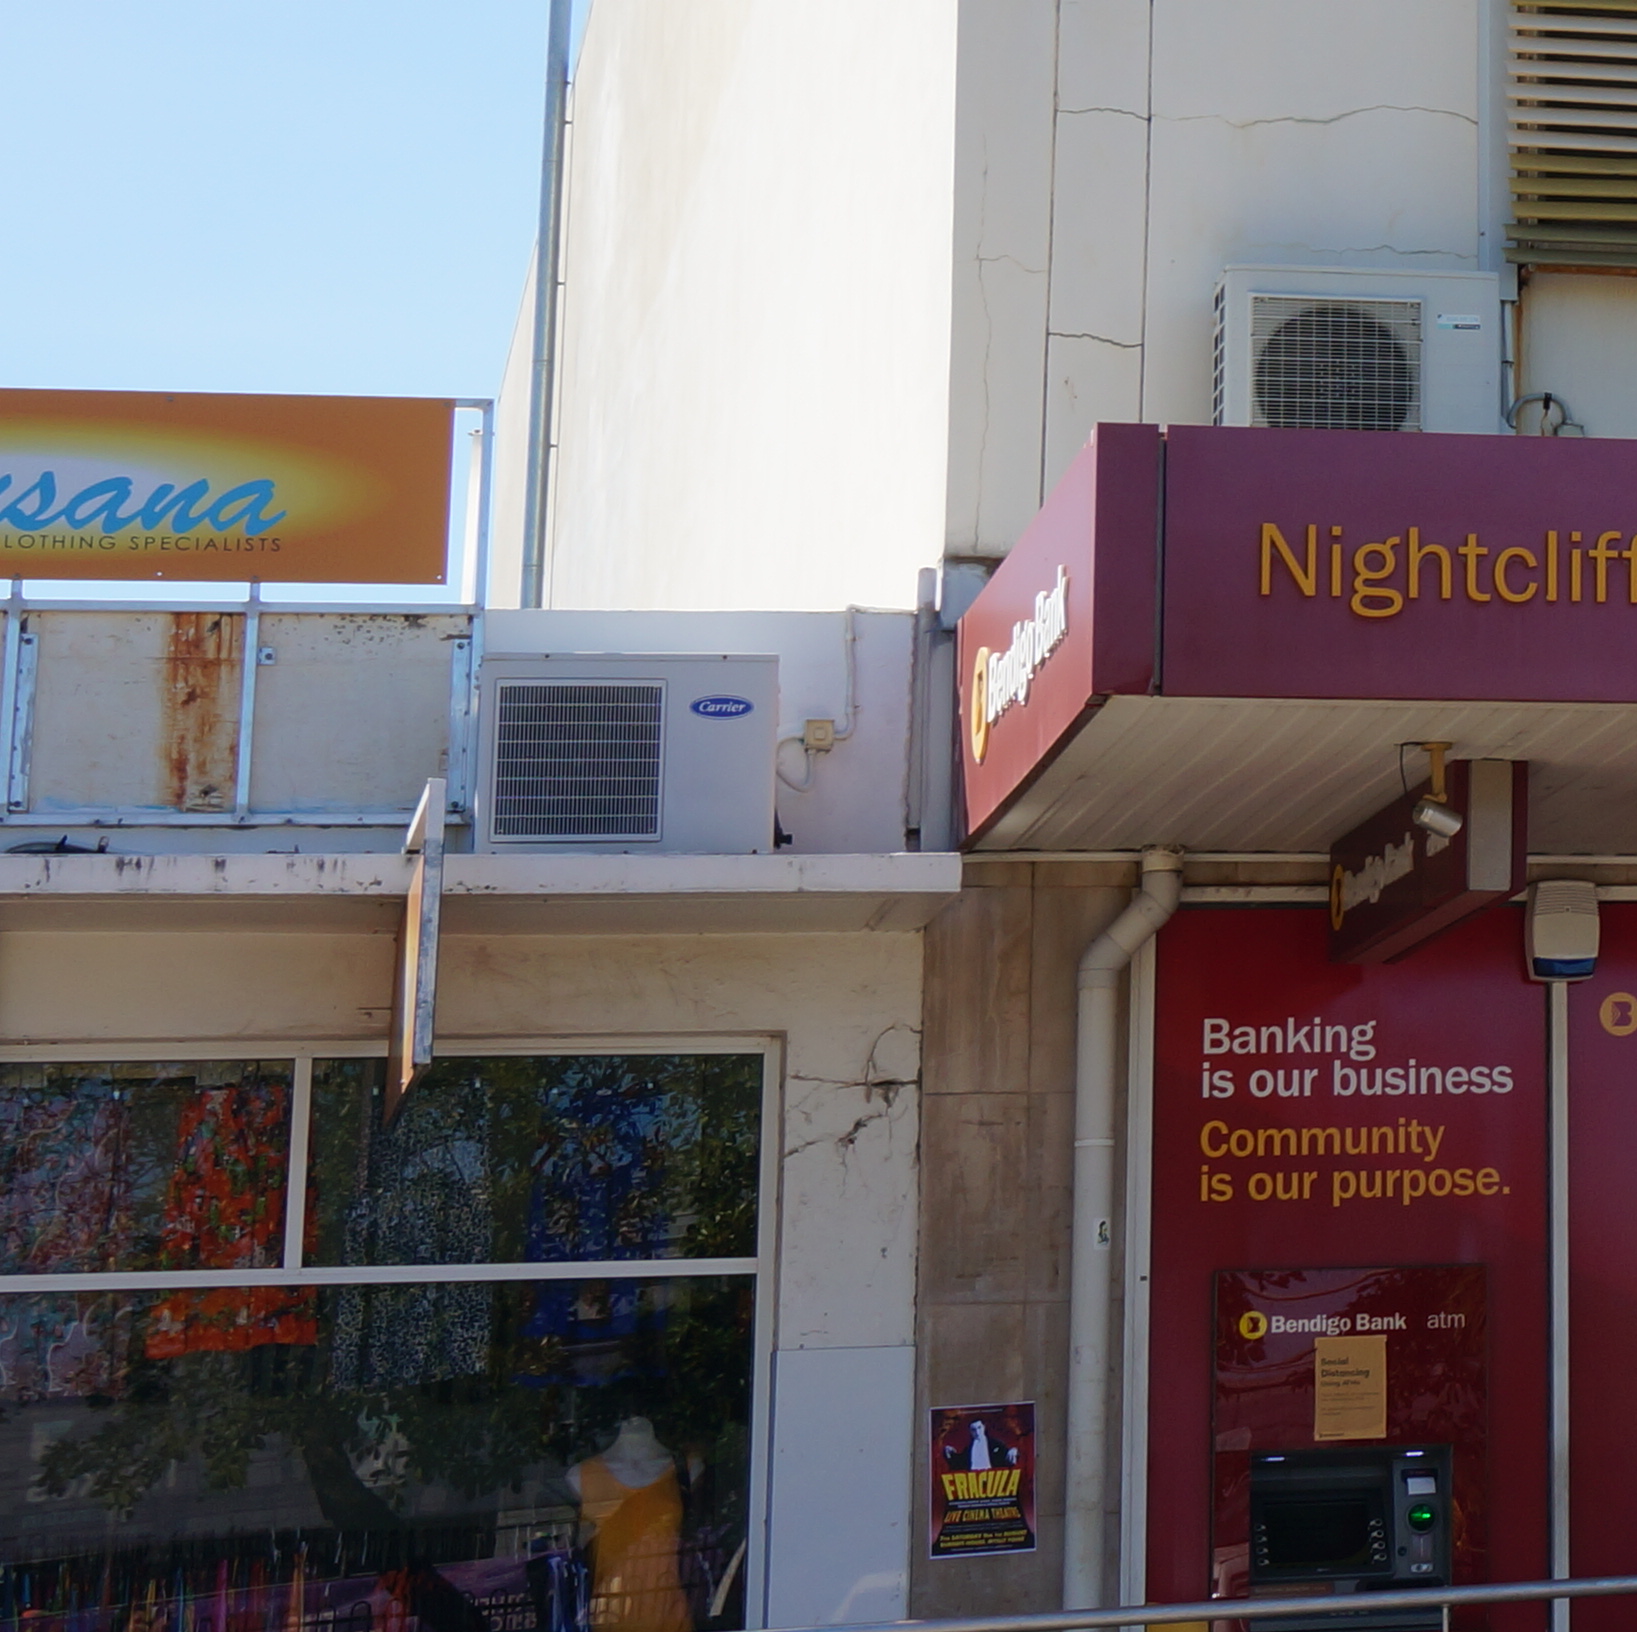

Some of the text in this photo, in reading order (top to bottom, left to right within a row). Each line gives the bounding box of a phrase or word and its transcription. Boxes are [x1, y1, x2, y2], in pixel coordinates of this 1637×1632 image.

[0, 470, 288, 536] sana
[3, 534, 282, 553] LOTHING SPECIALISTS
[988, 564, 1070, 724] Bendigo Bank
[698, 699, 746, 714] Carrier
[1202, 1016, 1377, 1061] Banking
[1201, 1058, 1514, 1099] is our business
[1200, 1118, 1446, 1161] Community
[1199, 1165, 1512, 1208] is our purpose.
[1270, 1310, 1466, 1336] Bendigo Bank atm
[940, 1468, 1022, 1501] FRACULA
